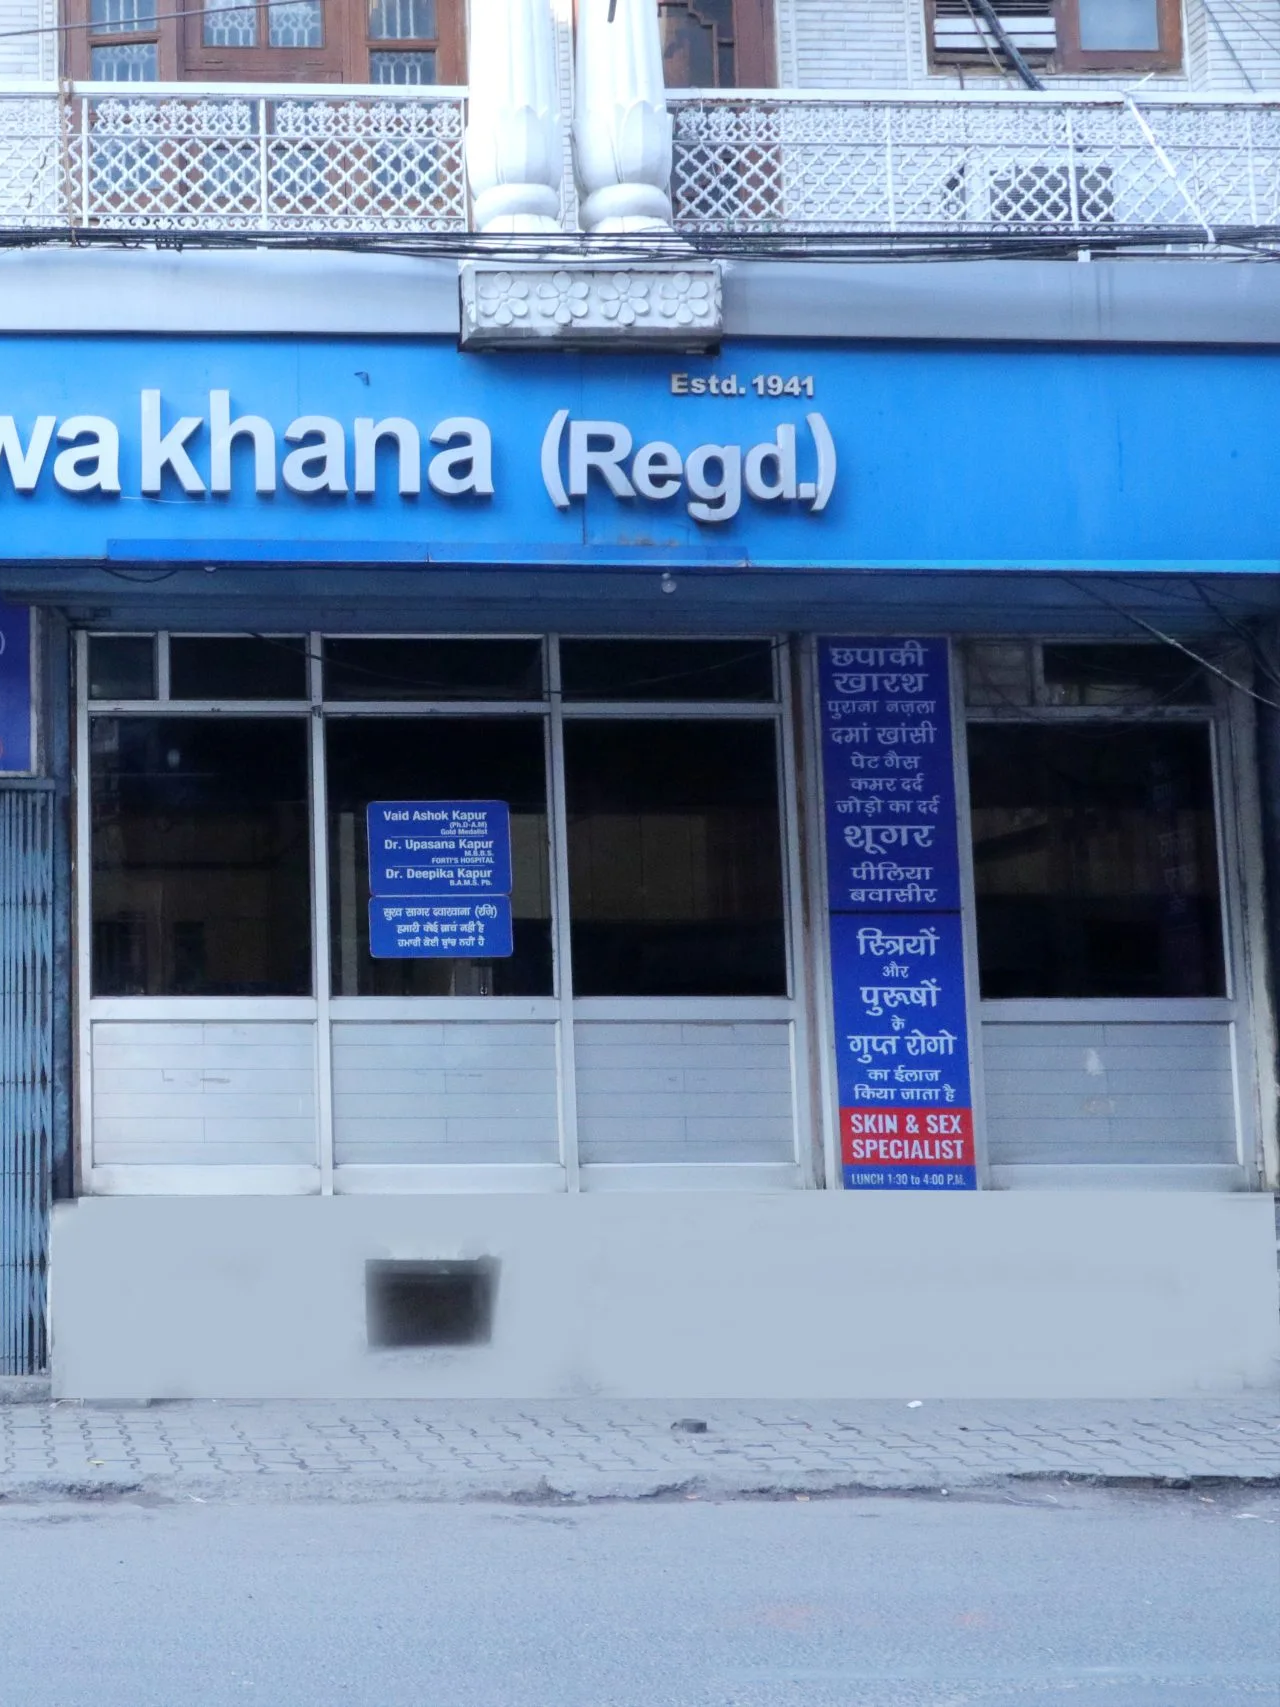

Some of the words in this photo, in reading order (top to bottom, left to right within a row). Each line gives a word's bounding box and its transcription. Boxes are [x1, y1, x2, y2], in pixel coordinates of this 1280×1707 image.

[670, 372, 747, 397] Estd.
[752, 374, 814, 397] 1941
[540, 408, 837, 522] (Regd.)
[830, 640, 928, 667] छपाकी
[832, 673, 928, 693] खारश
[827, 700, 880, 719] पुराना
[829, 723, 871, 744] दमां
[876, 721, 938, 745] खांसी
[850, 752, 880, 769] पेट
[884, 751, 921, 769] गैस
[849, 778, 897, 791] कमर
[901, 773, 925, 791] दर्द
[888, 800, 913, 814] का
[916, 796, 941, 814] दर्द
[383, 810, 409, 821] Vaid
[412, 810, 449, 821] Ashok
[452, 810, 487, 822] Kapur
[440, 828, 455, 836] Gold
[457, 828, 488, 836] Medalist
[844, 825, 935, 855] शूगर
[384, 839, 401, 850] Dr.
[405, 839, 455, 852] Upasana
[459, 838, 494, 851] Kapur
[385, 868, 403, 879] Dr.
[406, 868, 454, 881] Deepika
[457, 868, 492, 881] Kapur
[850, 862, 934, 881] पीलिया
[849, 883, 938, 903] बवासीर
[405, 907, 430, 917] सागर
[856, 926, 940, 957] स्त्रियों
[882, 961, 910, 978] और
[891, 1014, 905, 1032] के
[847, 1036, 900, 1064] गुप्त
[867, 1069, 891, 1082] का
[894, 1065, 941, 1083] ईलाज
[854, 1084, 895, 1101] किया
[901, 1088, 941, 1101] जाता
[944, 1084, 956, 1103] है
[850, 1113, 899, 1135] SKIN
[905, 1114, 919, 1134] &
[926, 1113, 962, 1135] SEX
[852, 1139, 964, 1160] SPECIALIST
[851, 1173, 884, 1186] LUNCH
[887, 1173, 908, 1186] 1:30
[910, 1175, 920, 1186] to
[923, 1173, 944, 1185] 4:00
